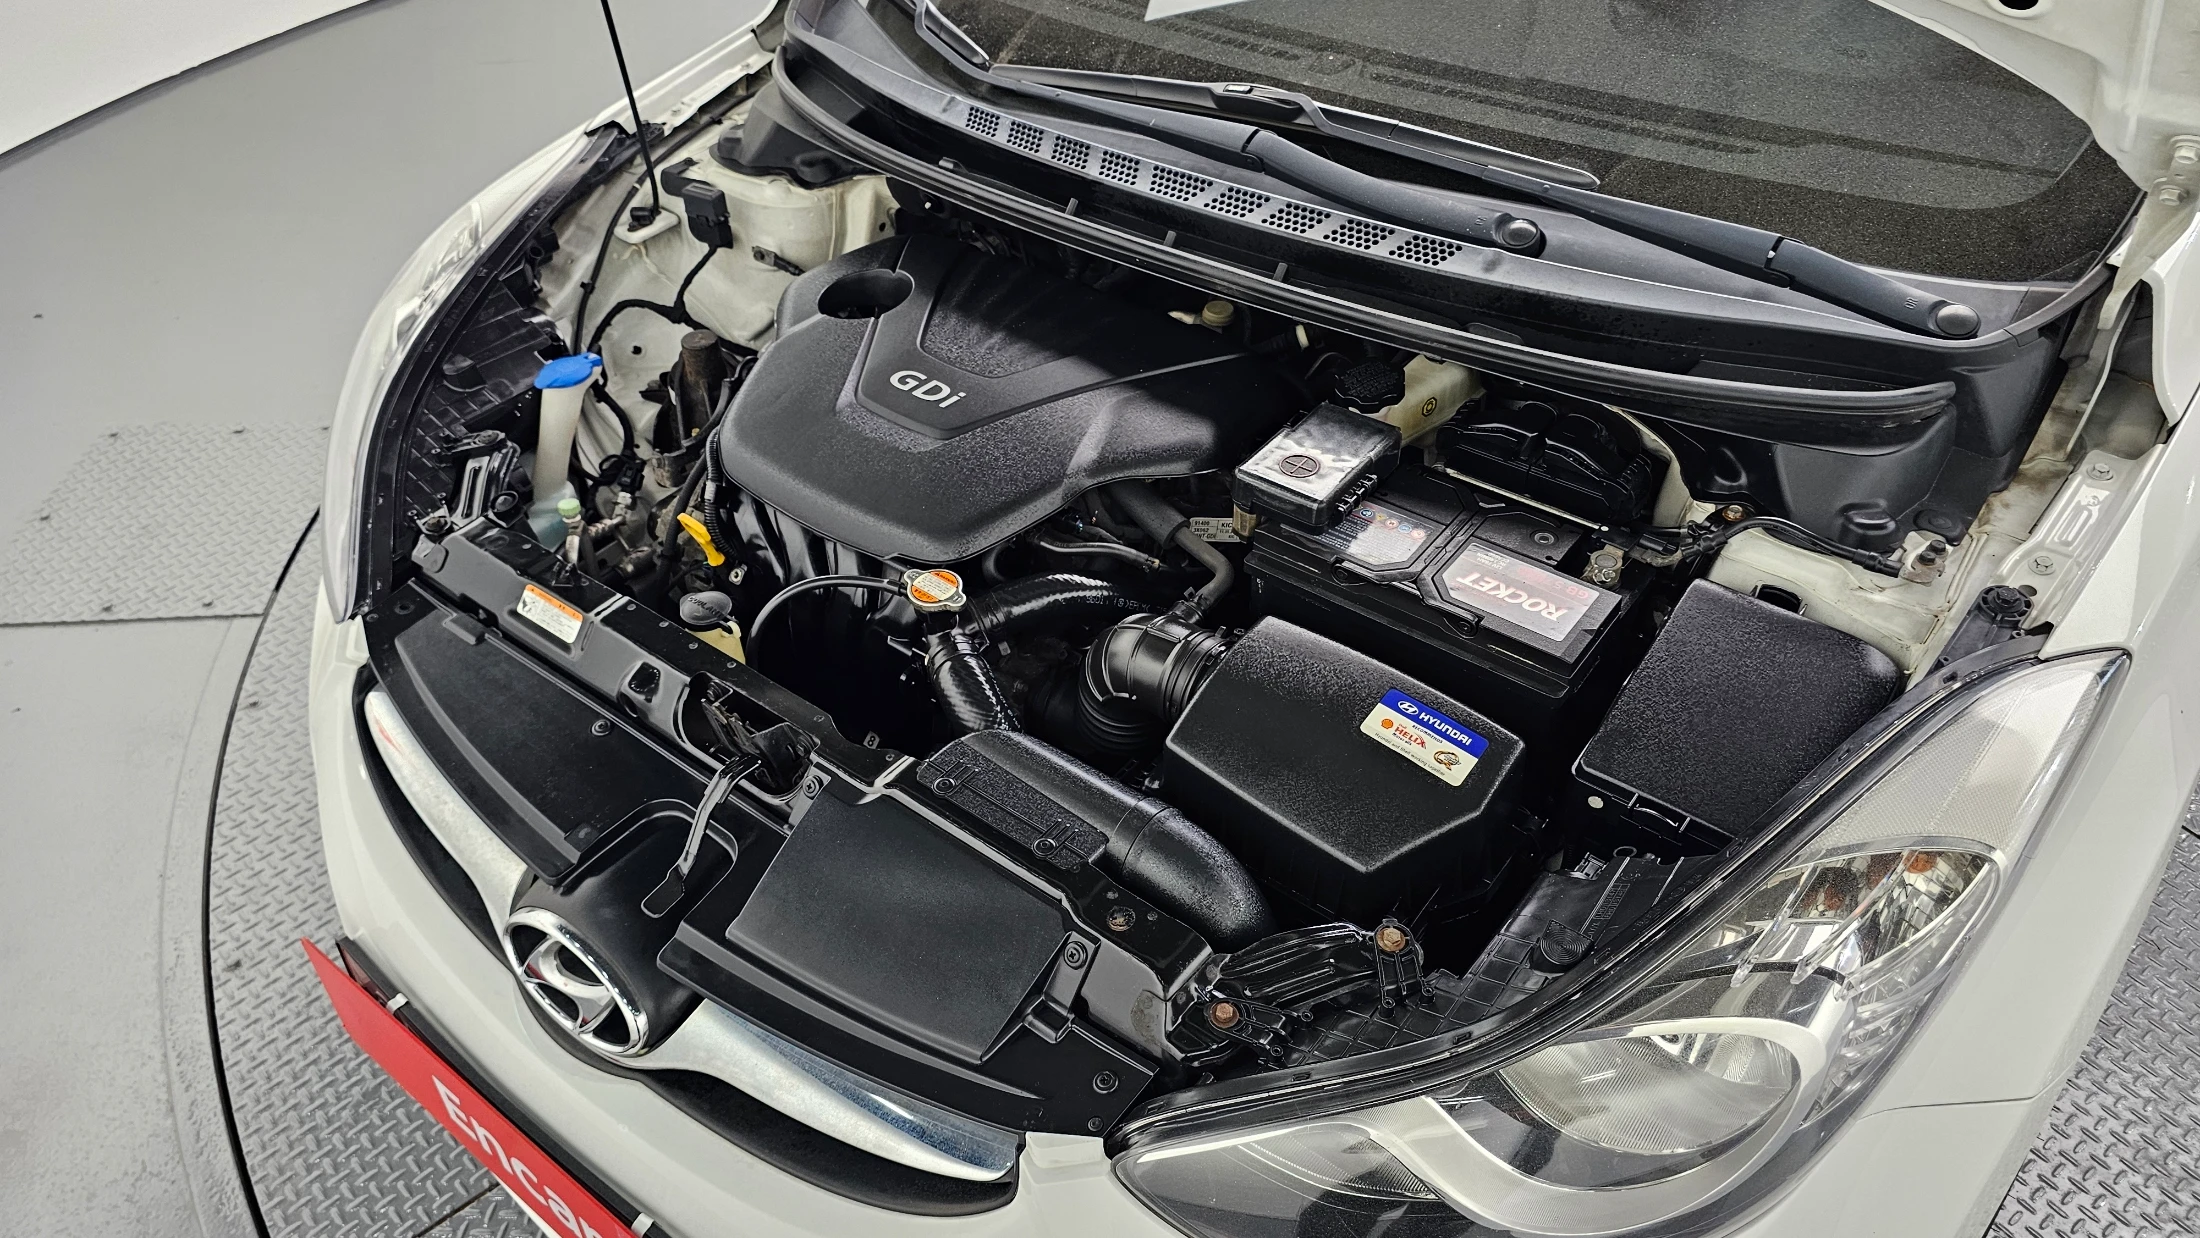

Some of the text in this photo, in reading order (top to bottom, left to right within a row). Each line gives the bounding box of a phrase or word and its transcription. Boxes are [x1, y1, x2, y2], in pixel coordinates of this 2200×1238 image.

[889, 370, 967, 408] GDi
[1456, 571, 1568, 622] ROCKET
[1394, 726, 1426, 748] HELIX
[1418, 712, 1473, 746] HYUNDAI
[1410, 753, 1427, 767] working
